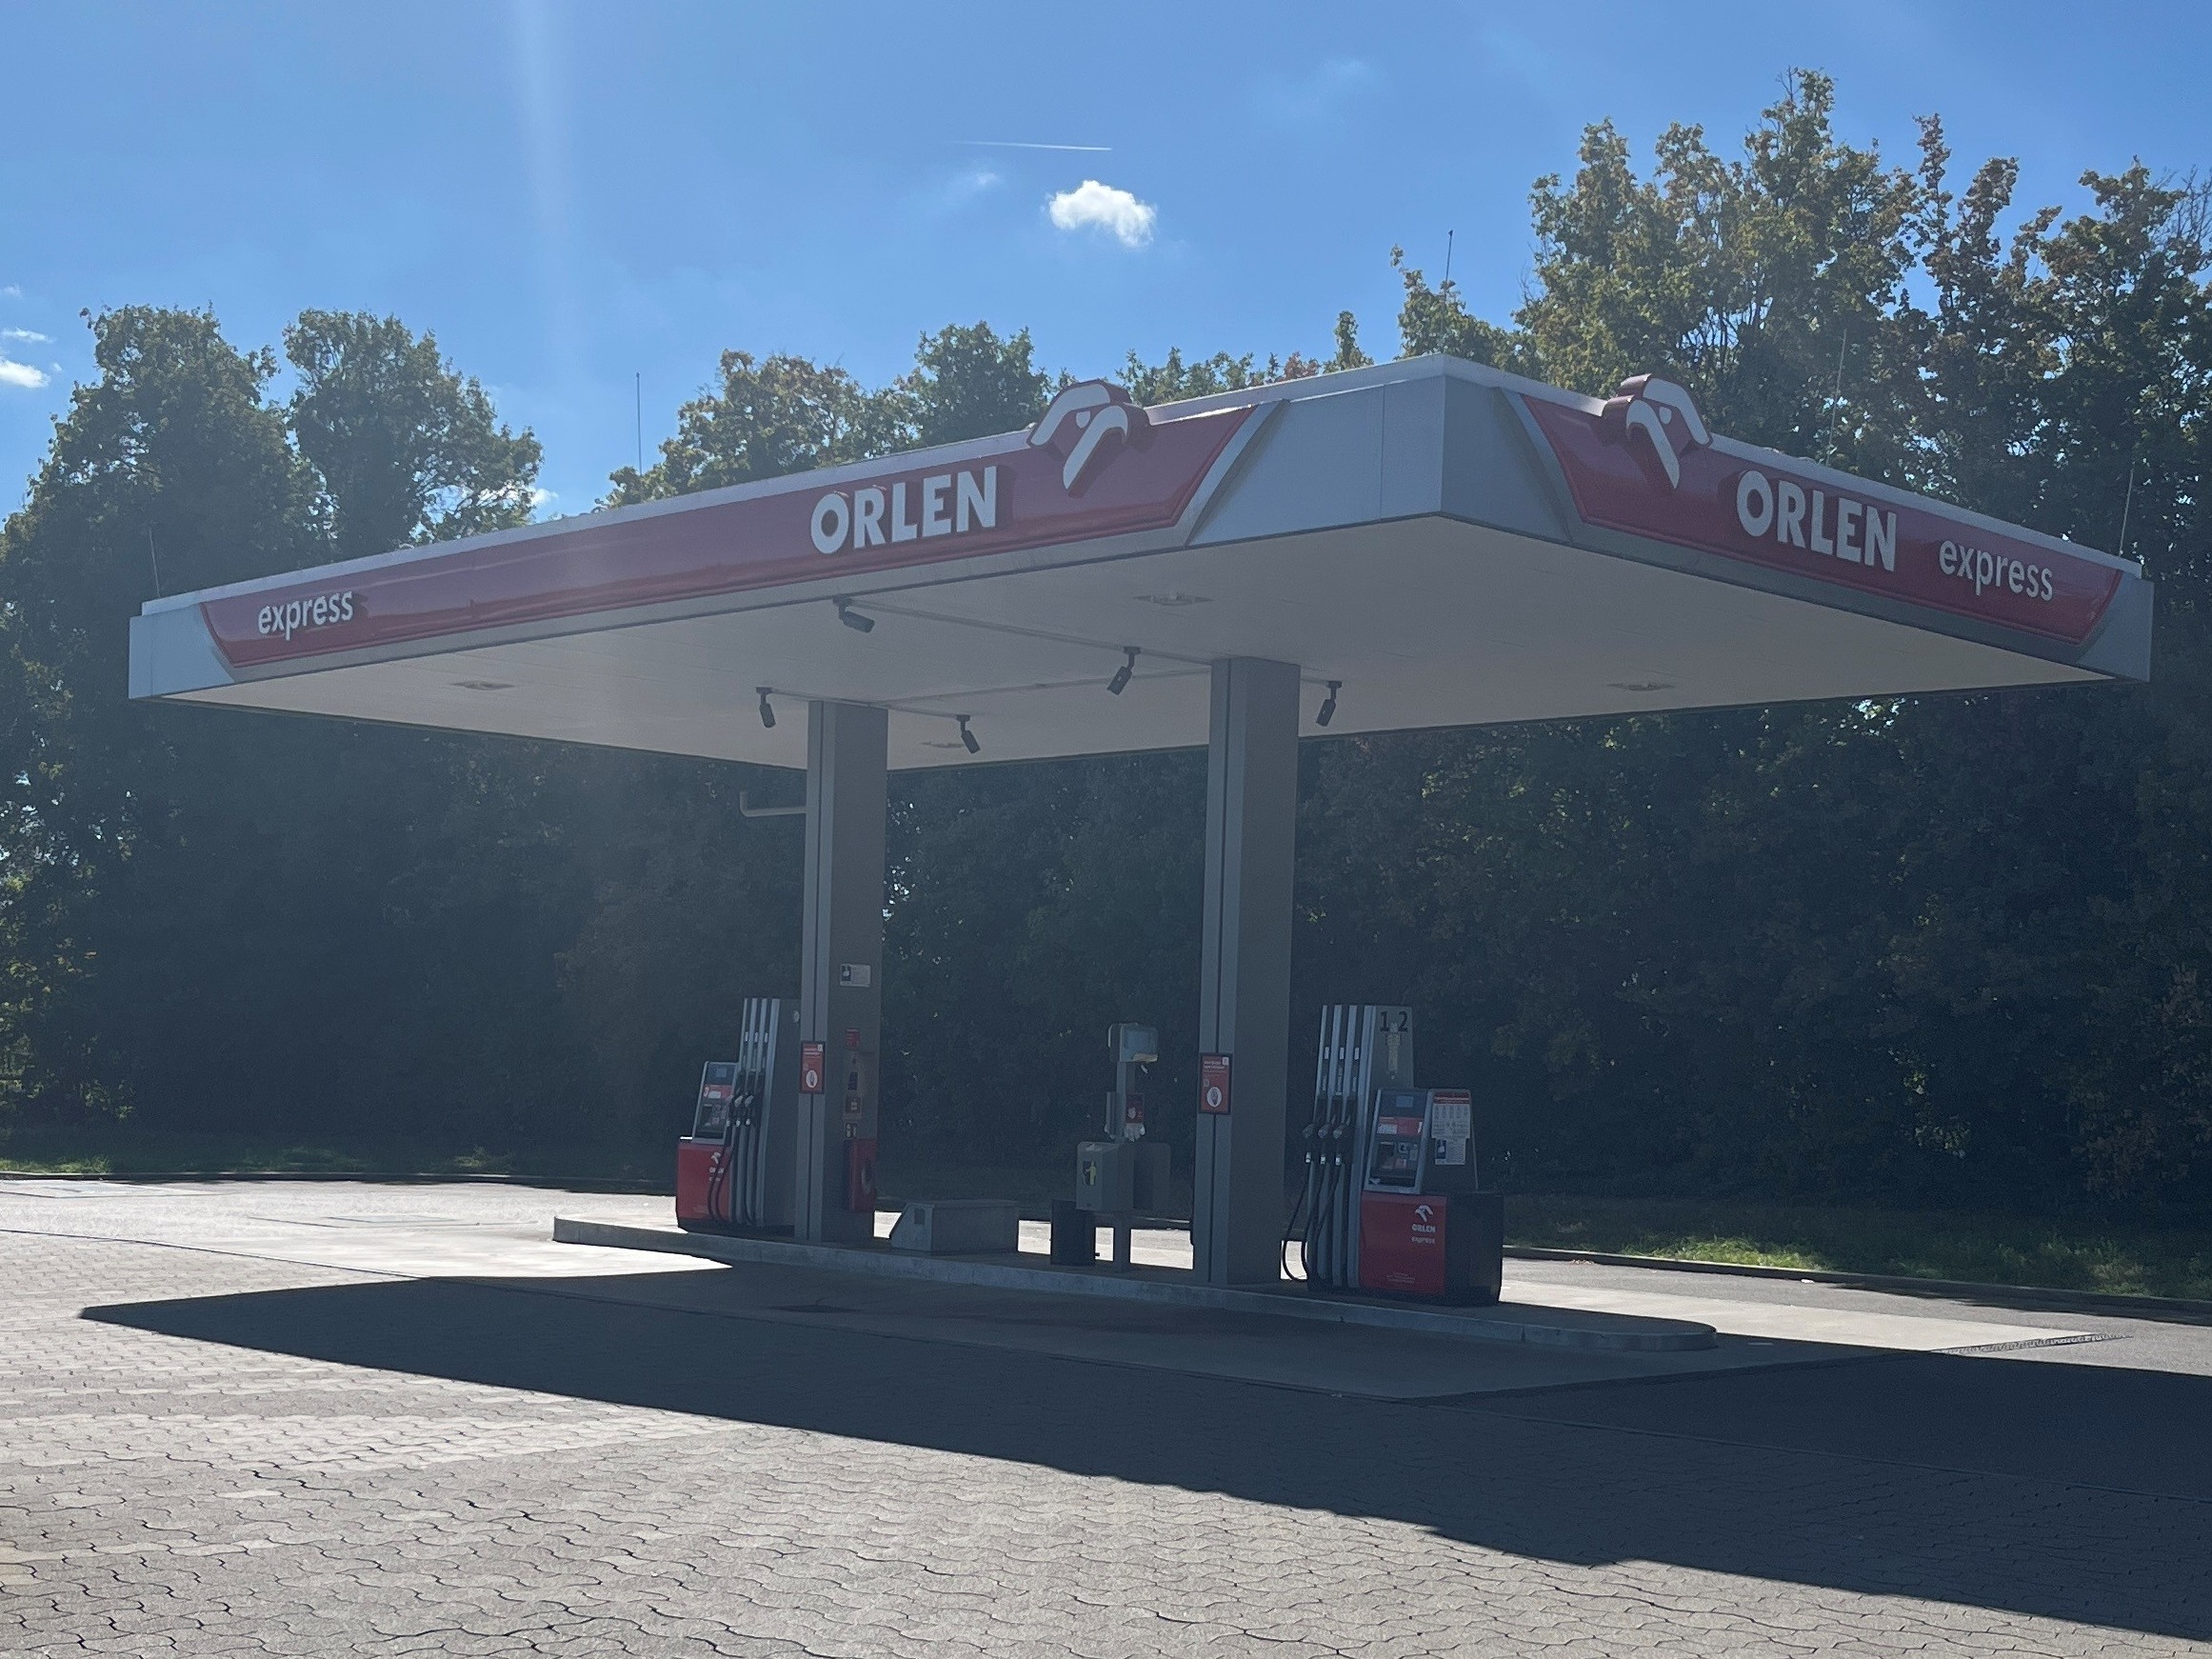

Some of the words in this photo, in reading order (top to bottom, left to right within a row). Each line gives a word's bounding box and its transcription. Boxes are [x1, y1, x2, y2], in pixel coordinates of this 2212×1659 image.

[810, 466, 997, 554] ORLEN
[1737, 470, 1897, 571] ORLEN
[1939, 539, 2054, 601] express
[257, 590, 353, 641] express
[1380, 1010, 1390, 1032] 1
[1398, 1010, 1408, 1032] 2
